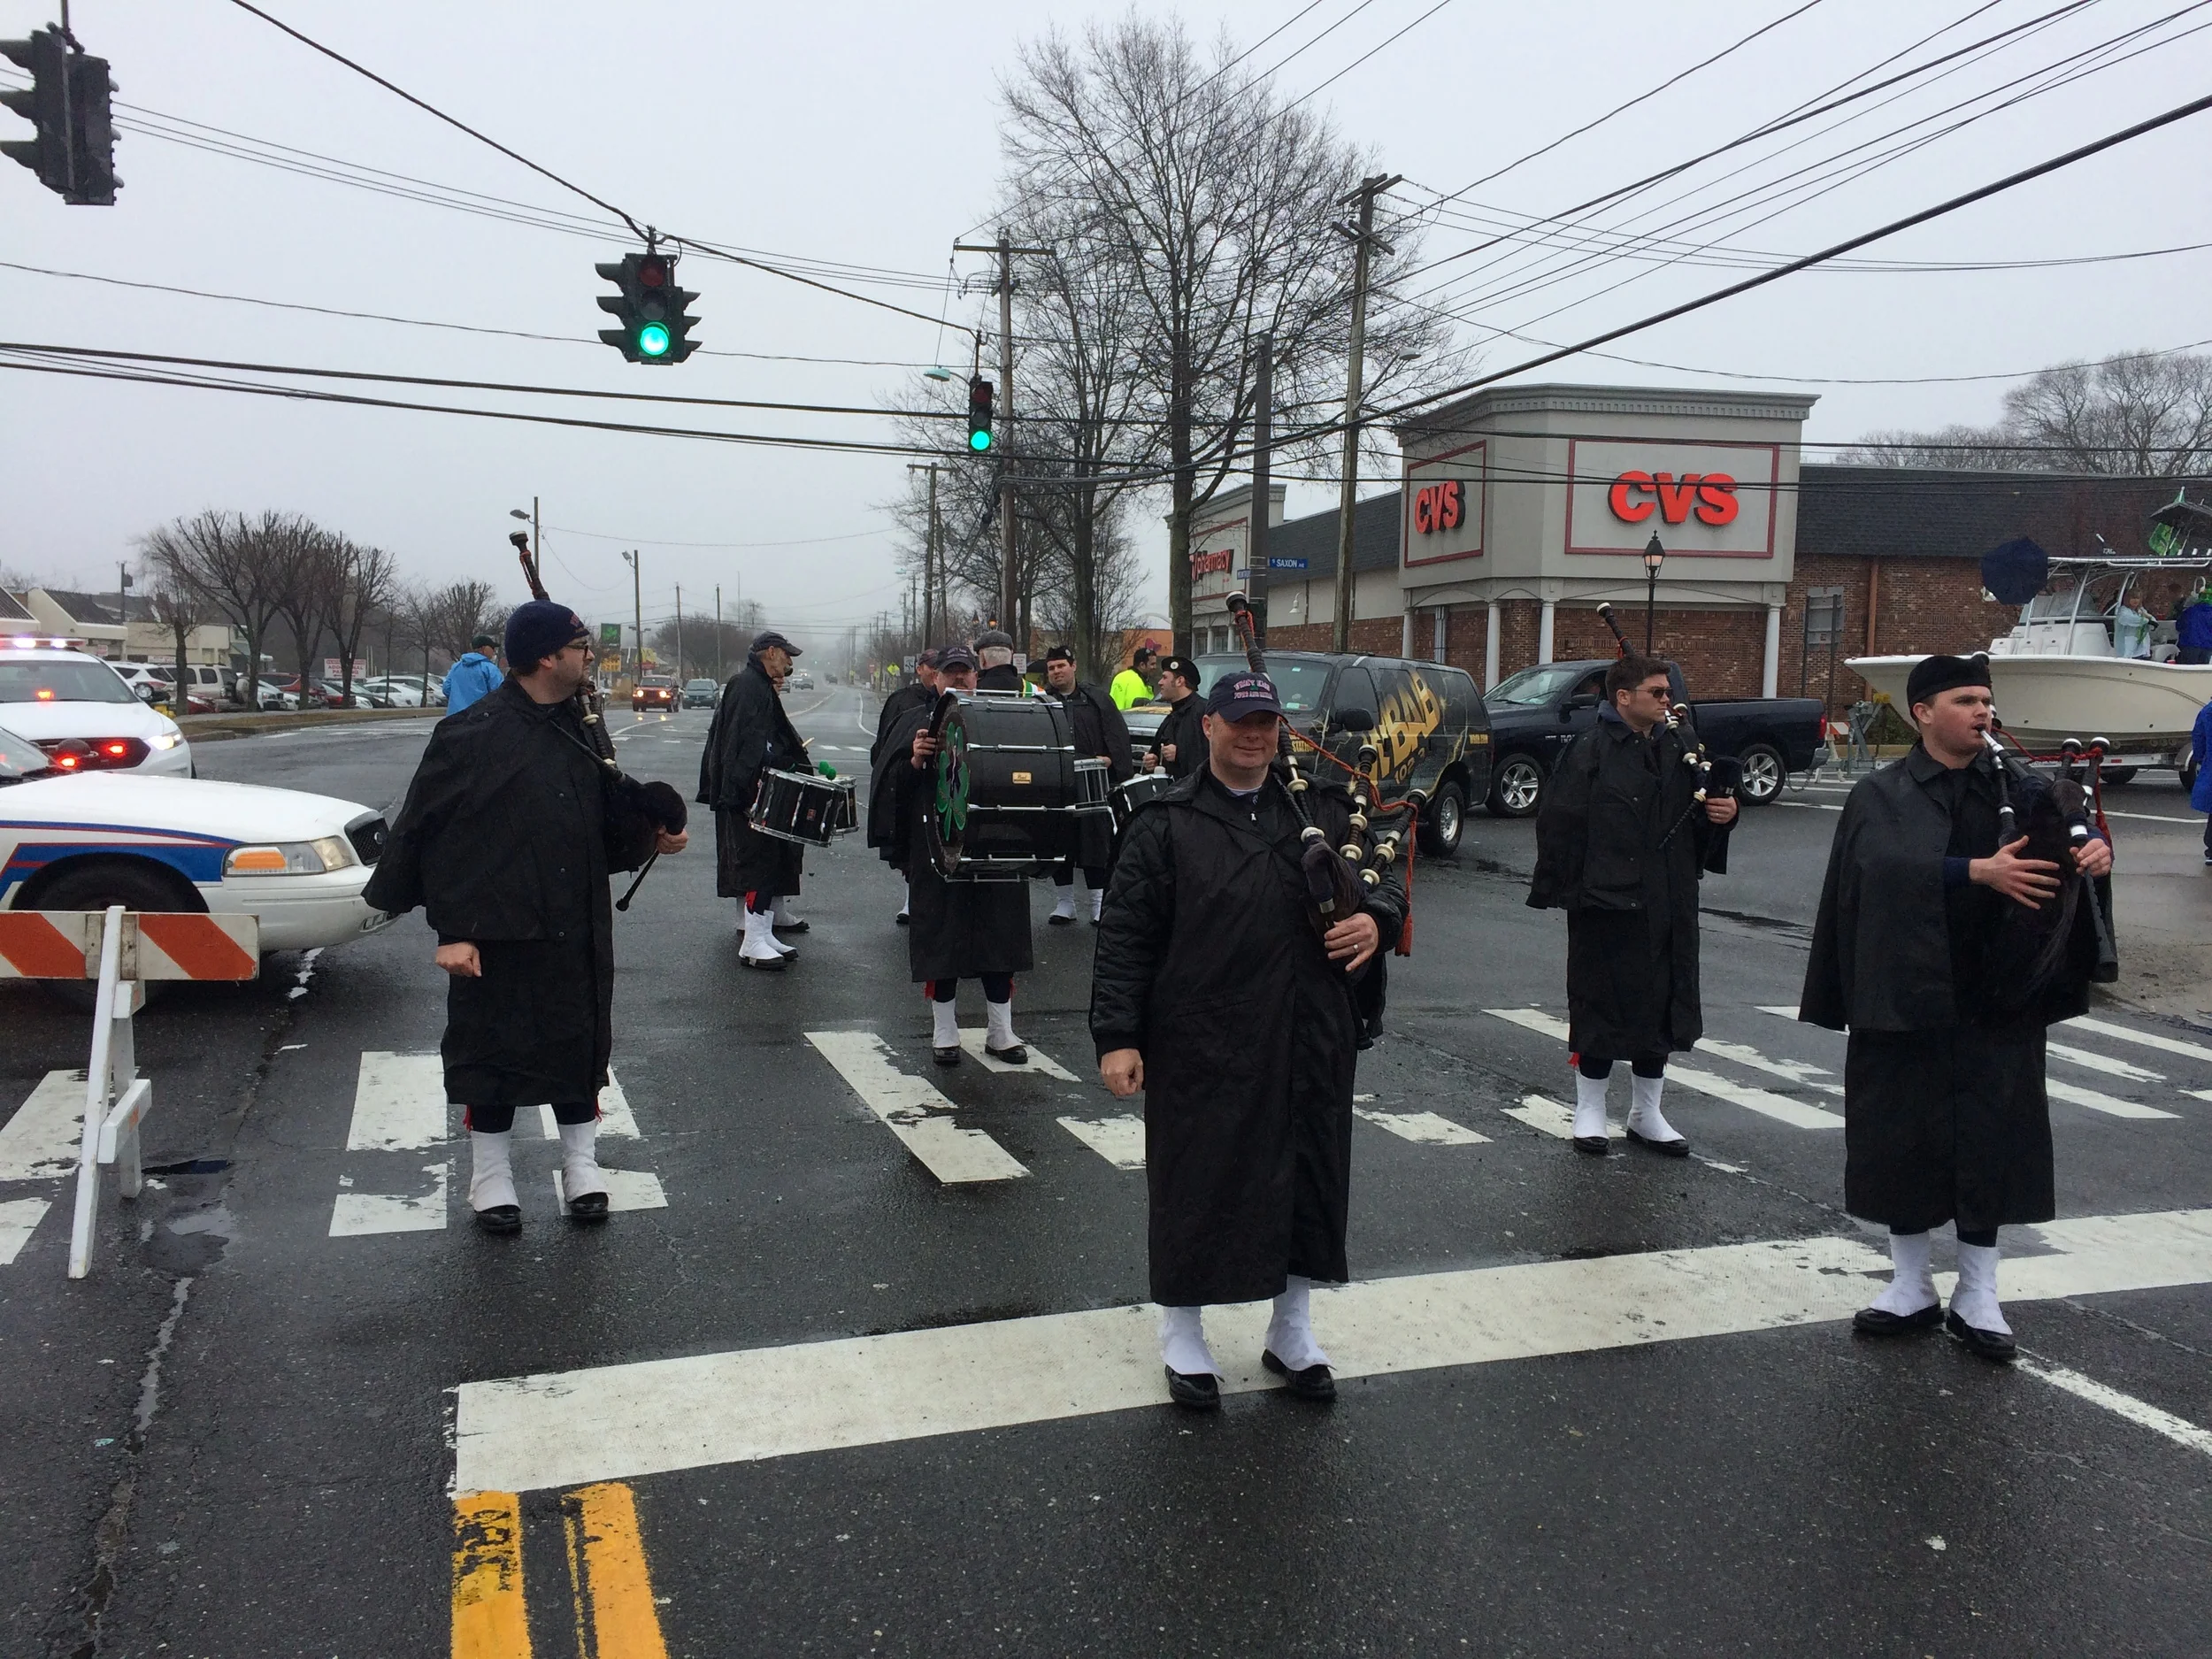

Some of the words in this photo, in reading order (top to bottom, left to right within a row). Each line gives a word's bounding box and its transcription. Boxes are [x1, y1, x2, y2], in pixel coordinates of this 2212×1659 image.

[1415, 479, 1463, 534] CVS
[1608, 470, 1740, 526] CVS
[1276, 558, 1297, 568] SAXON
